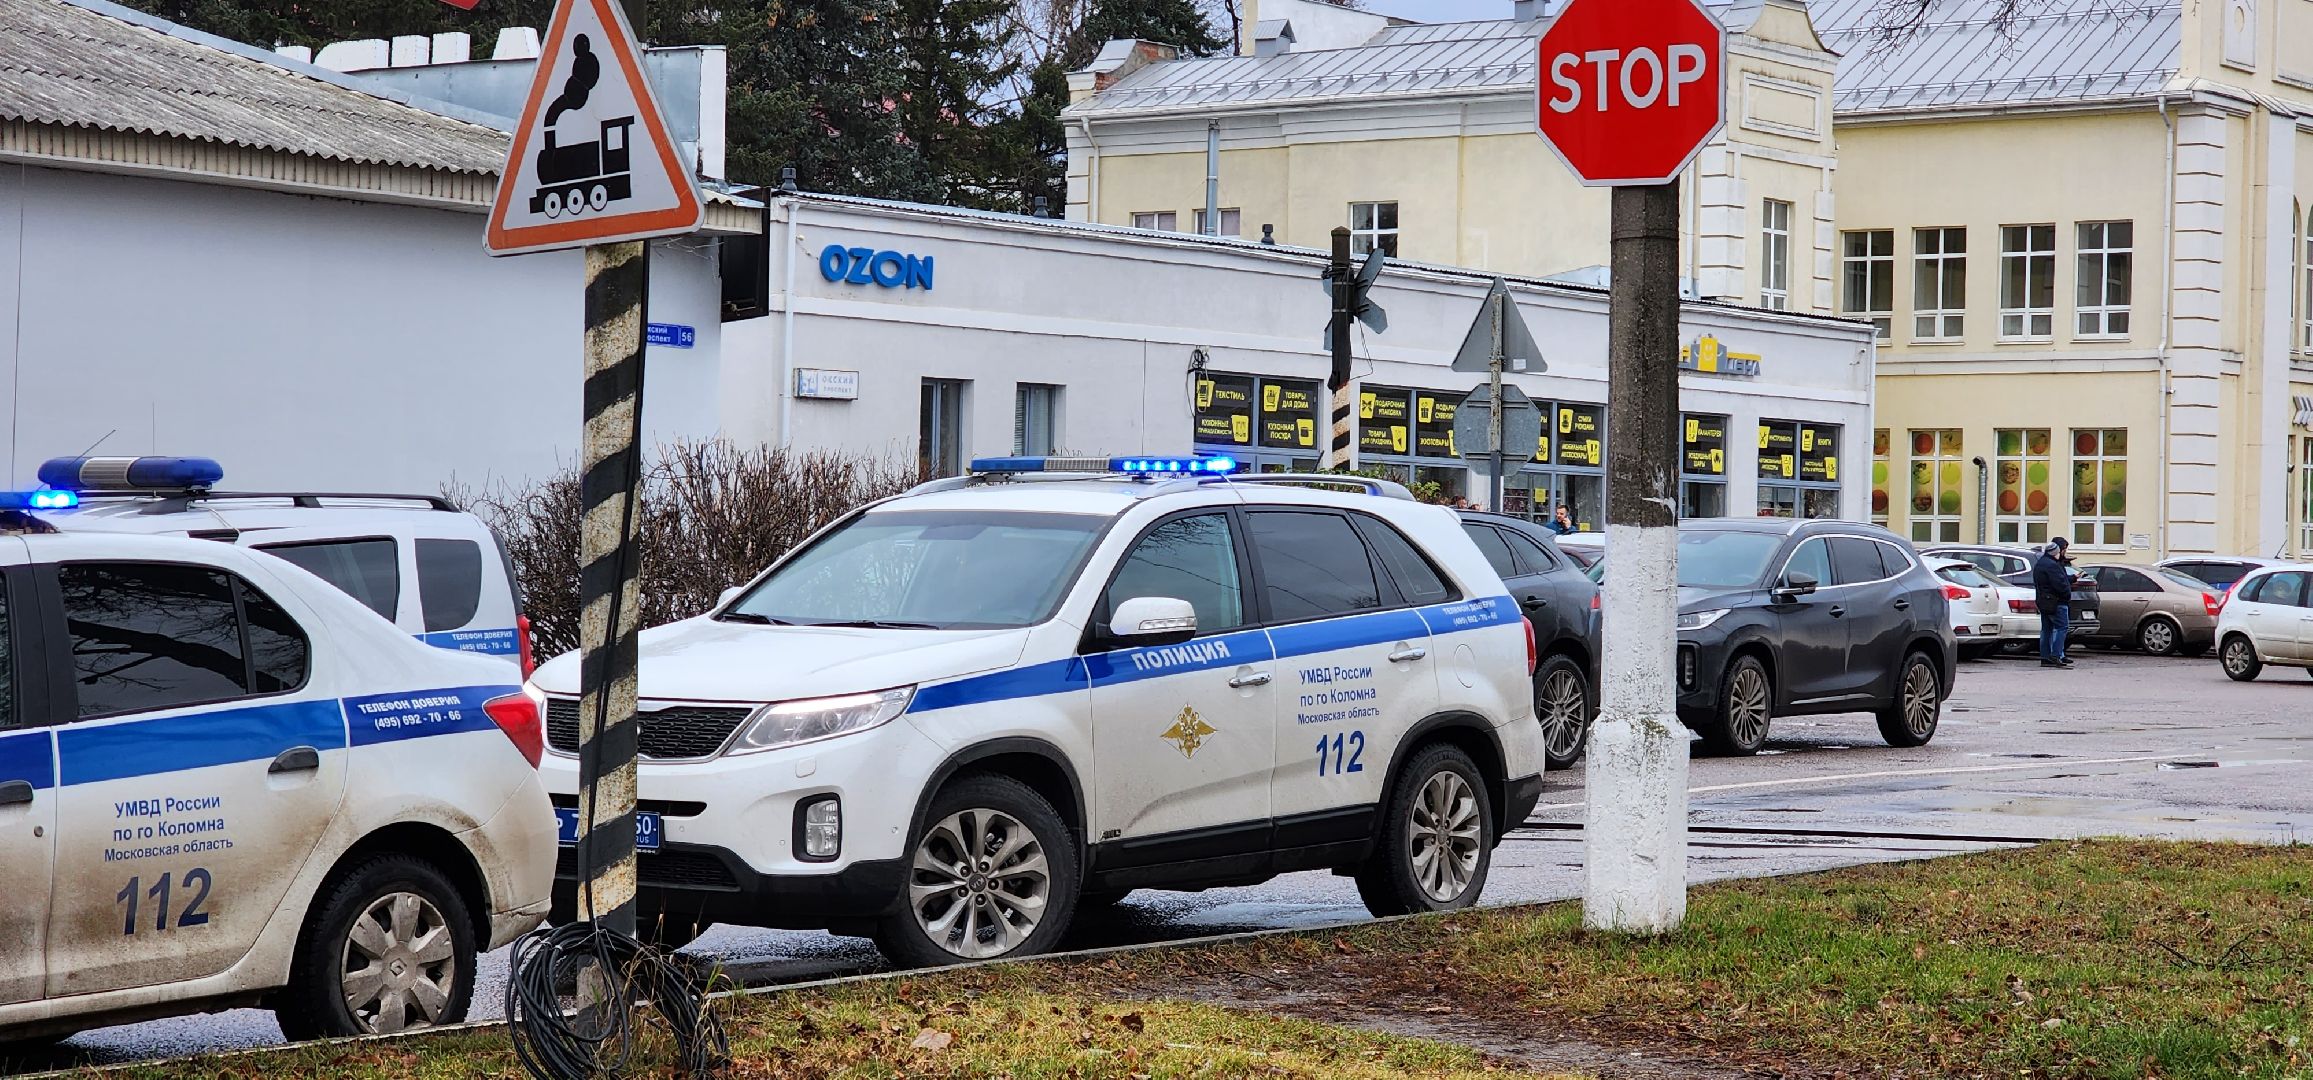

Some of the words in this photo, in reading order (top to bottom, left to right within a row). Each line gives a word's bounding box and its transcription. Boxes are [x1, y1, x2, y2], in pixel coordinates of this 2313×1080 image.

[1549, 43, 1707, 113] STOP
[820, 245, 934, 290] OZON
[647, 335, 671, 343] оспект
[681, 332, 692, 342] 56
[1215, 390, 1245, 401] ТЕКСТИЛЬ
[1281, 400, 1293, 409] ДЛЯ
[1293, 401, 1309, 409] ДОМА
[1285, 391, 1307, 400] ТОВАРЫ
[1267, 422, 1295, 431] КУХОННАЯ
[1270, 431, 1291, 440] ПОСУДА
[1368, 430, 1386, 438] ТОВАРЫ
[452, 633, 483, 641] ТЕЛЕФОН
[483, 630, 513, 640] ДОВЕРИЯ
[1130, 640, 1231, 671] ПОЛИЦИЯ
[1299, 668, 1332, 685] УМВД
[1334, 666, 1373, 681] России
[357, 700, 411, 715] ТЕЛЕФОН
[410, 695, 461, 710] ДОВЕРИЯ
[1300, 695, 1314, 707] по
[1316, 693, 1328, 705] го
[1330, 687, 1376, 703] Коломна
[374, 716, 402, 732] (495)
[402, 714, 423, 726] 692
[428, 711, 442, 723] 70
[448, 710, 462, 721] 66
[1297, 711, 1346, 726] Московская
[1348, 706, 1380, 719] область
[1316, 730, 1365, 777] 112
[115, 799, 161, 819] УМВД
[165, 796, 221, 813] России
[113, 827, 132, 842] по
[137, 826, 153, 840] го
[158, 818, 225, 837] Коломна
[104, 843, 180, 862] Московская
[182, 838, 234, 854] область
[116, 867, 212, 936] 112
